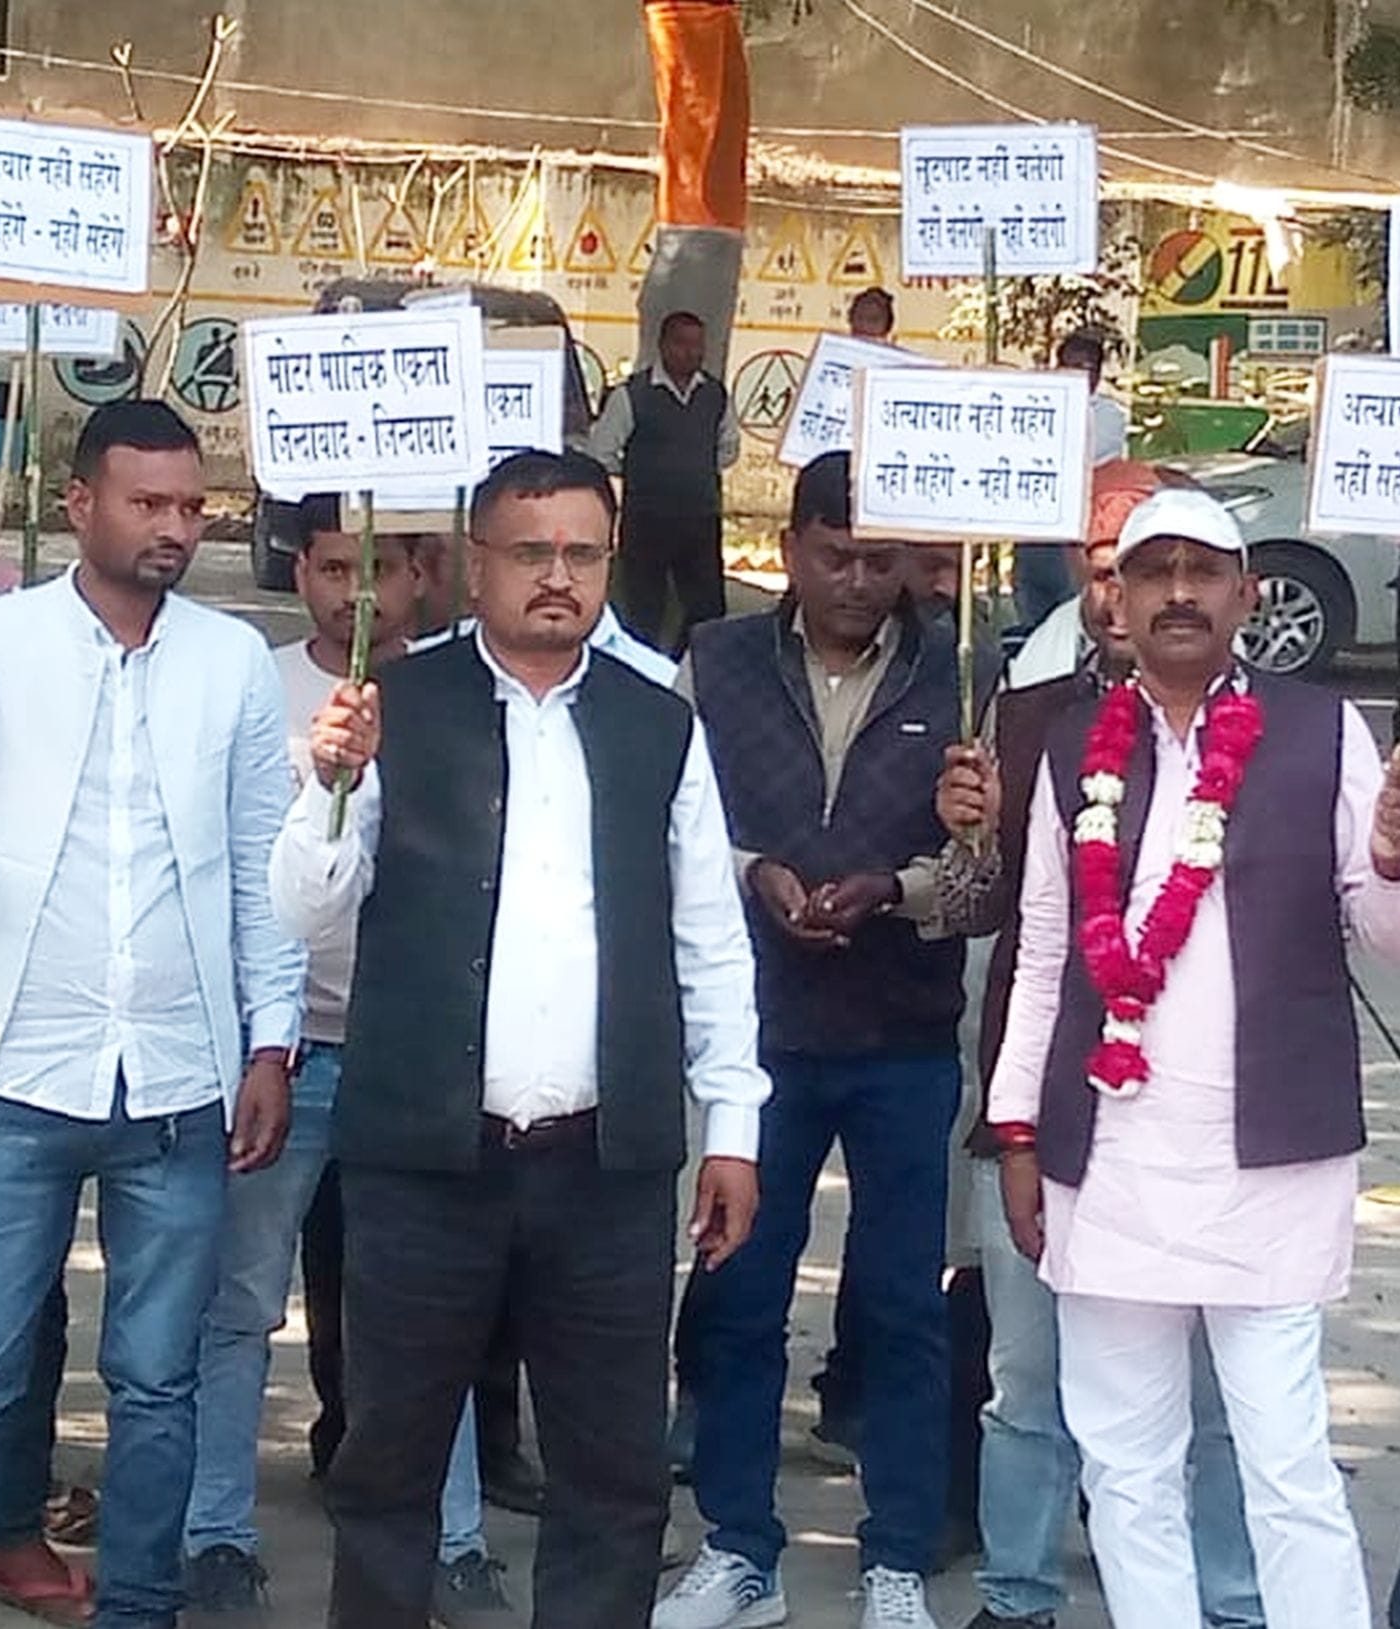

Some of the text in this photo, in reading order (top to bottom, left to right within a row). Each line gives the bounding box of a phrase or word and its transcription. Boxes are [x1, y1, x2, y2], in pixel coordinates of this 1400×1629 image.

[39, 147, 72, 192] नहीं
[78, 151, 121, 197] सहेंगे
[915, 145, 1064, 194] लूटपाट नहीं चलेगी
[50, 208, 80, 257] नहीं
[86, 213, 124, 262] सहेंगे
[917, 204, 942, 250] नहीं
[1001, 204, 1025, 251] नहीं
[1028, 203, 1066, 249] चलेगी
[268, 334, 450, 394] मोटर मालिक एकता
[882, 393, 1056, 440] अत्याचार नहीं सहेंगे
[877, 451, 908, 499] नहीं
[914, 453, 955, 502] सहेंगे
[980, 457, 1011, 505] नहीं
[1018, 459, 1058, 506] सहेंगे
[1334, 450, 1371, 500] नहीं
